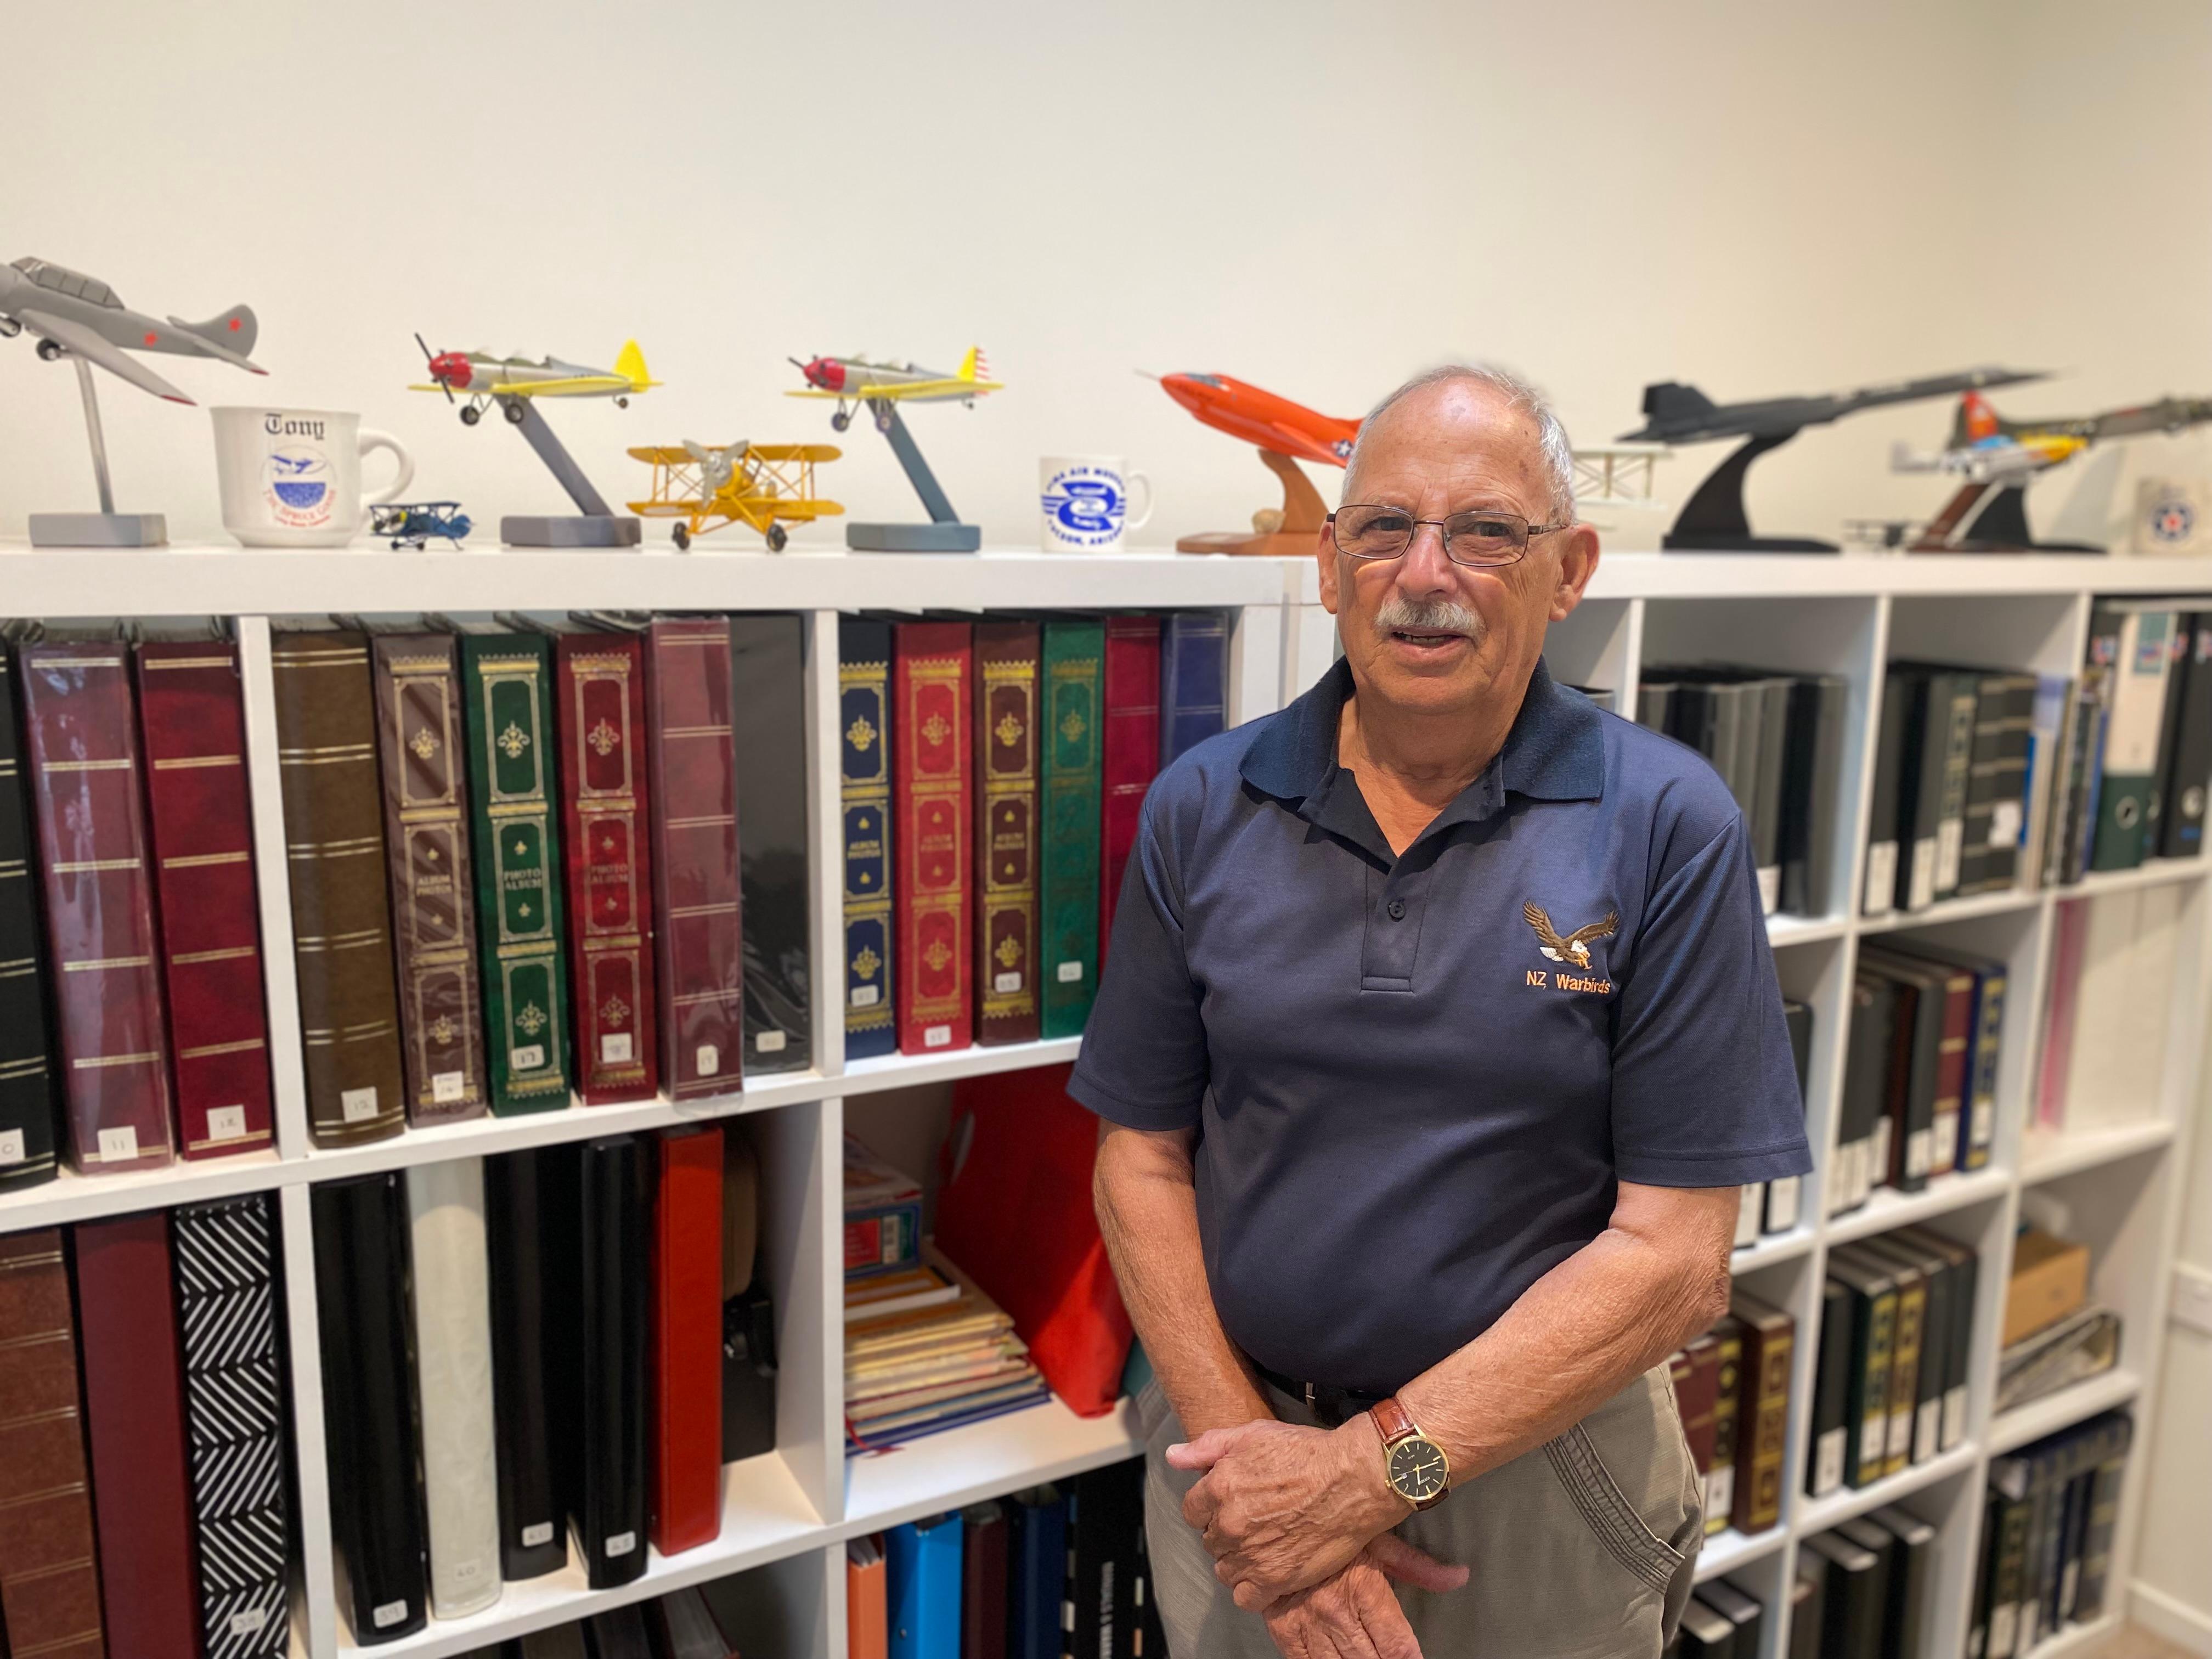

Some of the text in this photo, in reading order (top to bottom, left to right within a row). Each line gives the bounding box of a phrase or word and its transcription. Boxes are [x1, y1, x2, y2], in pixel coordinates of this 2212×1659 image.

[265, 413, 324, 440] Tony
[503, 868, 541, 881] PHOTO
[504, 878, 542, 890] ALBUM
[1527, 970, 1610, 994] NZ Warbirds
